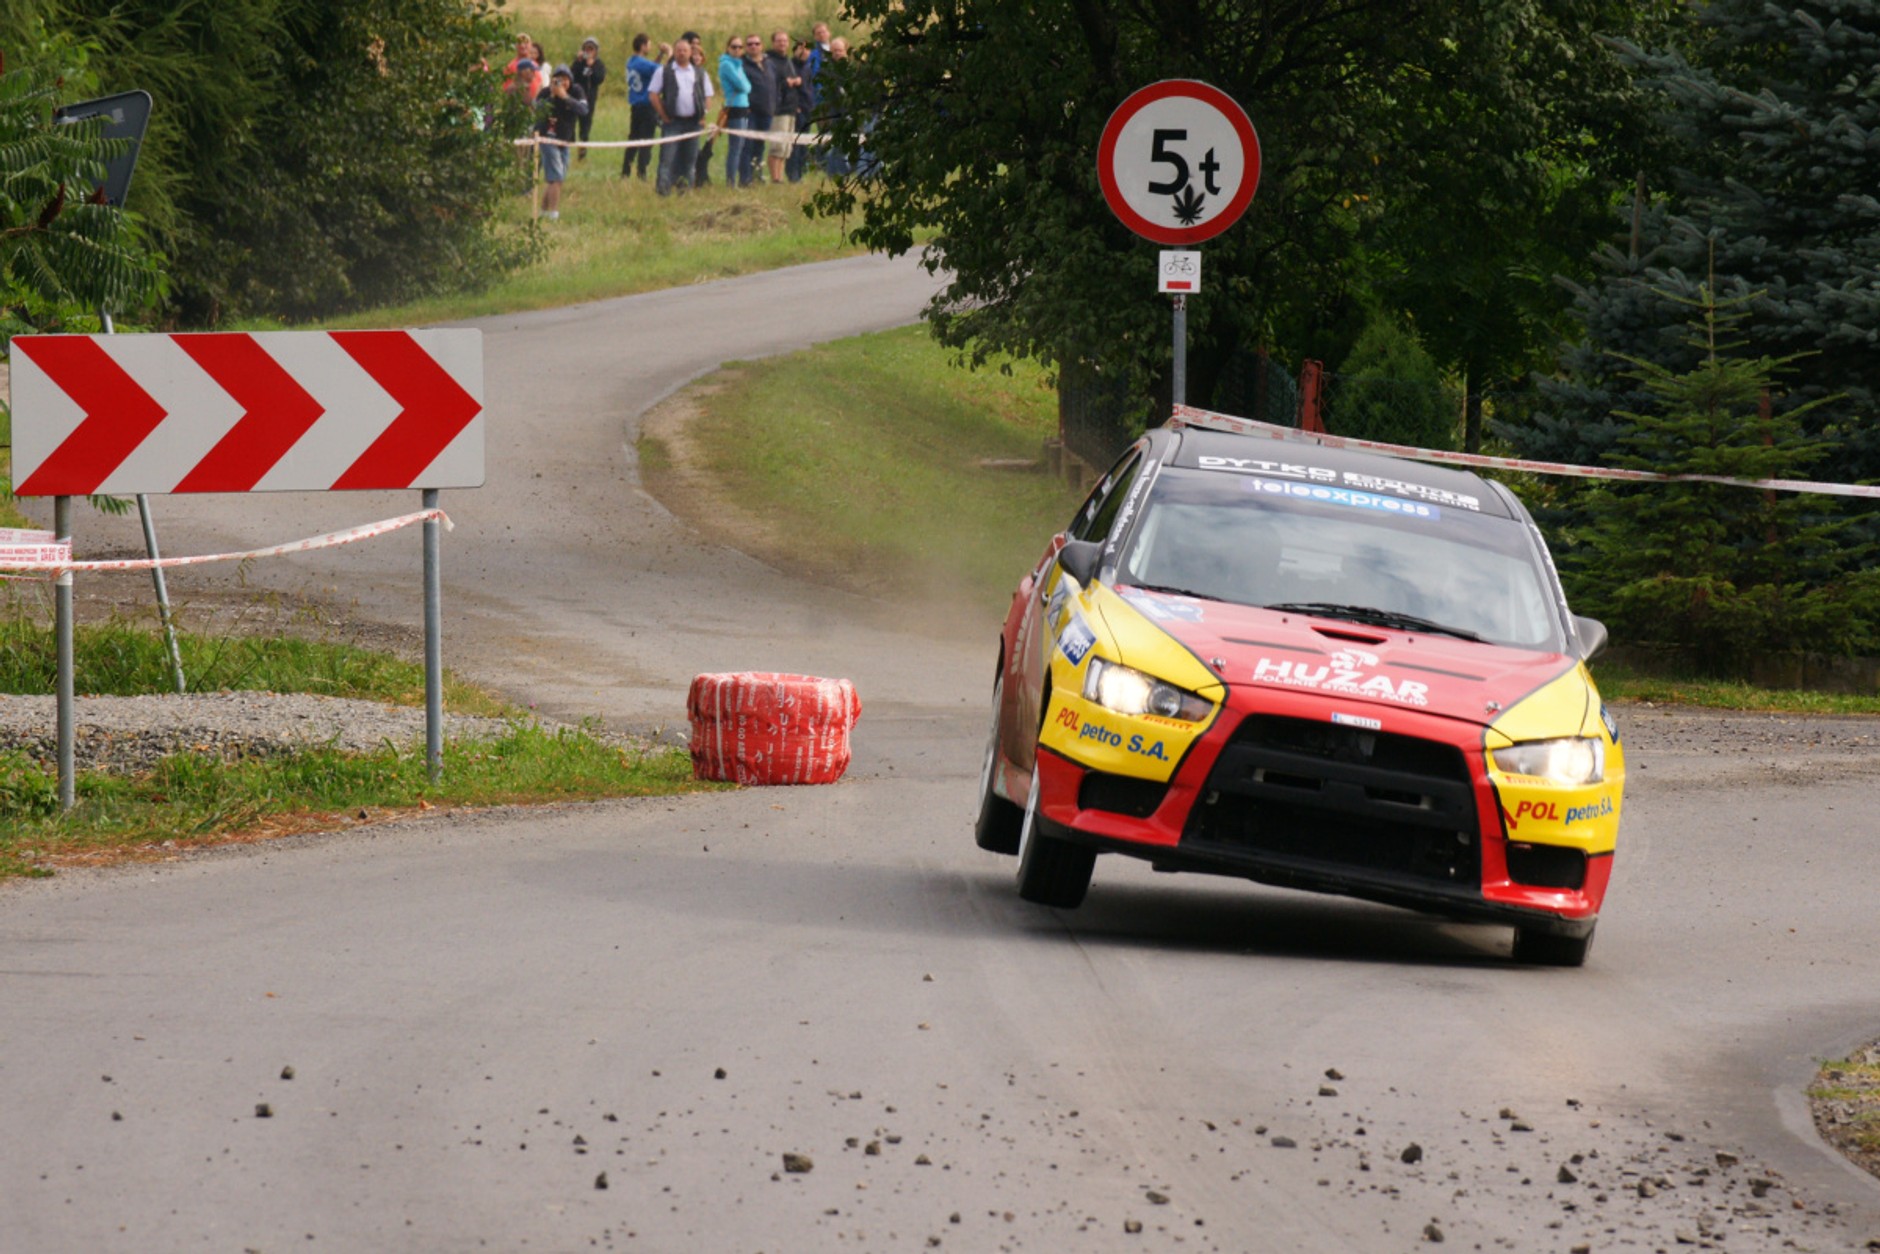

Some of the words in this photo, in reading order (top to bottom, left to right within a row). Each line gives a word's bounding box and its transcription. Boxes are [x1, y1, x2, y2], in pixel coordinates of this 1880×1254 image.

[1199, 456, 1336, 478] DYTKO
[1252, 479, 1430, 516] teleexpress
[1056, 707, 1079, 731] POL
[1079, 722, 1122, 747] petro
[1127, 735, 1169, 762] S.A.
[1515, 801, 1559, 820] POL
[1565, 804, 1599, 825] petro
